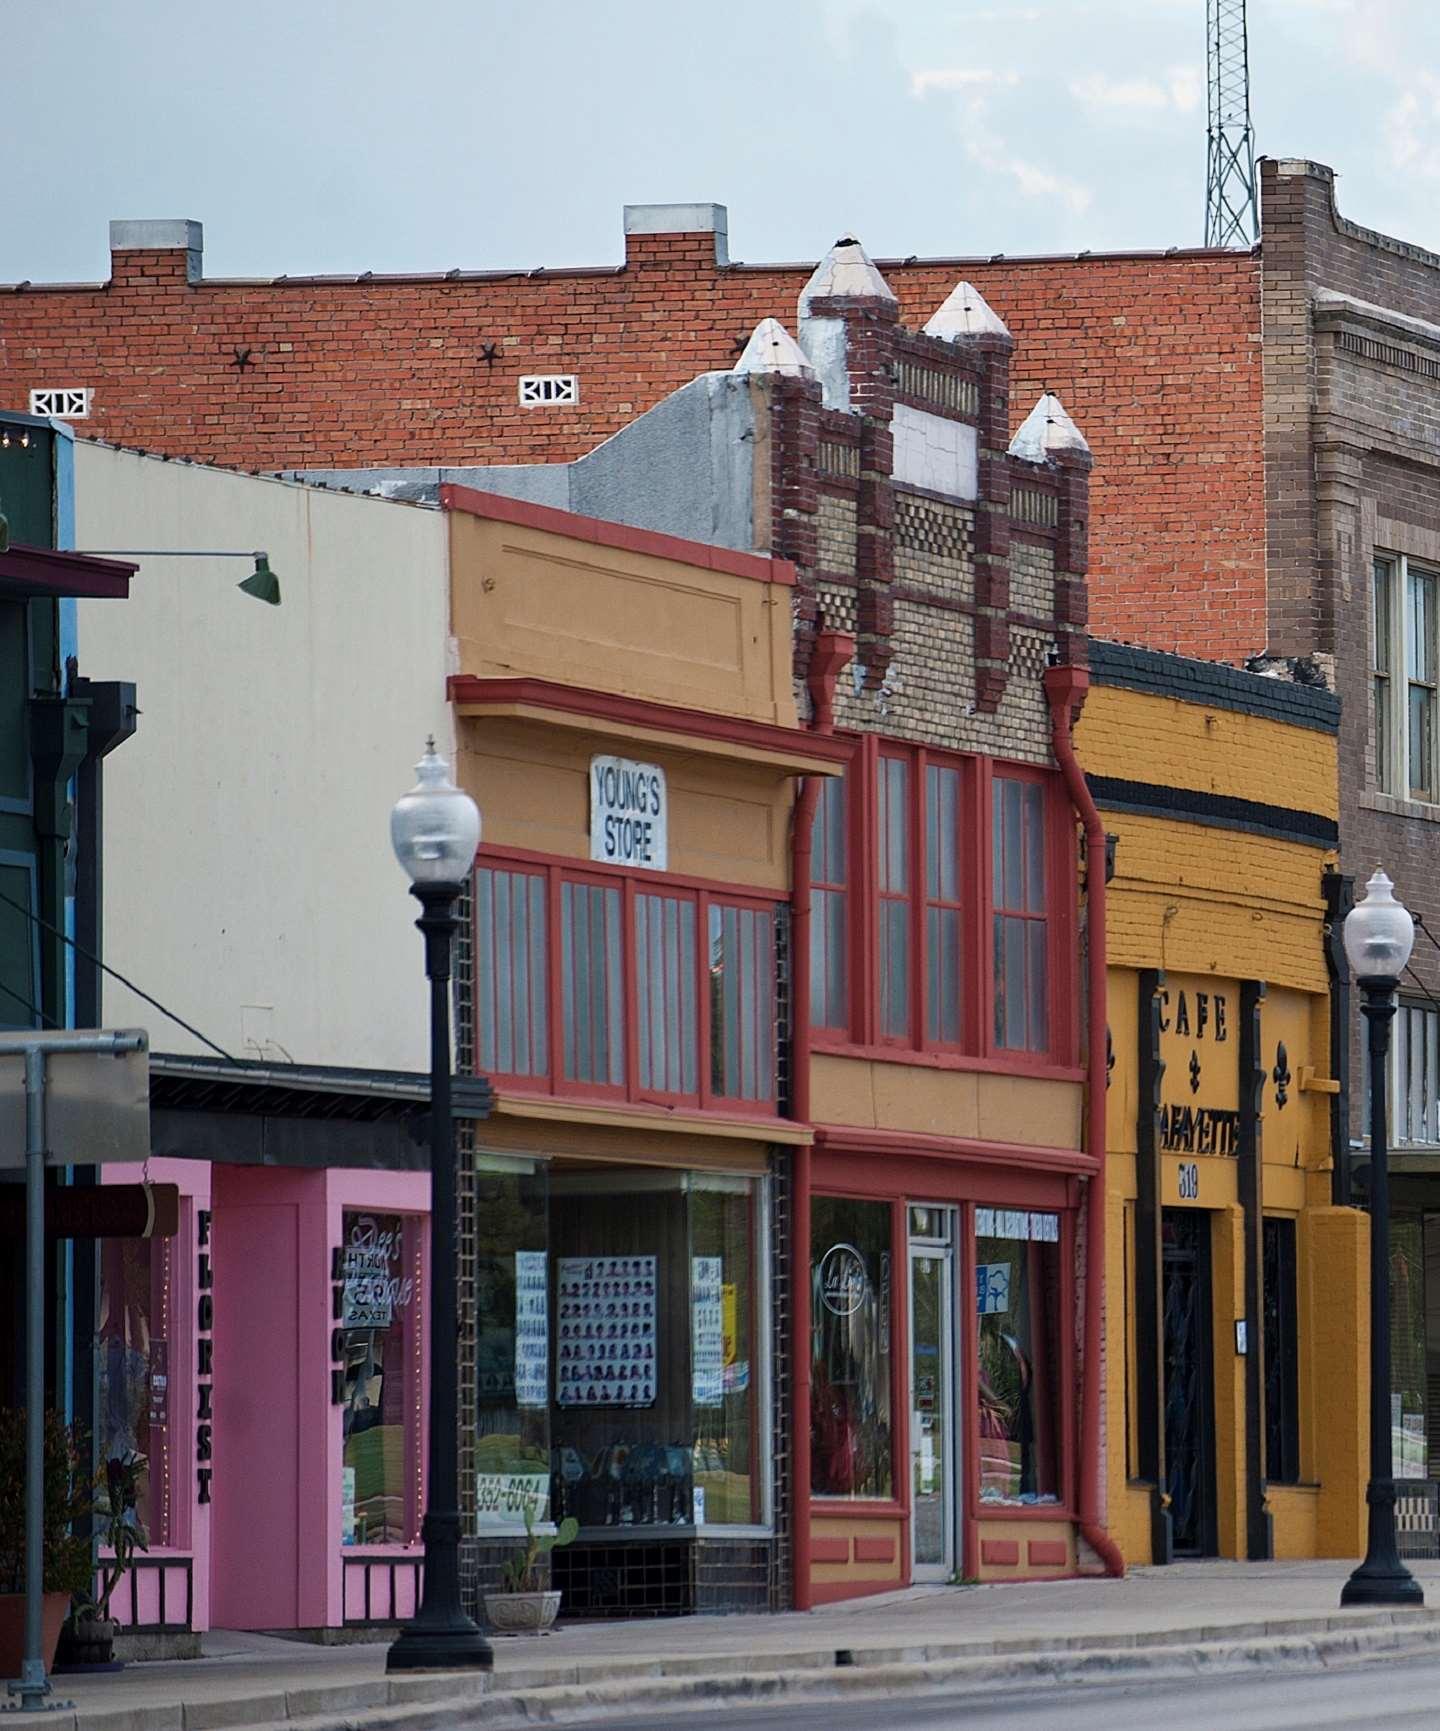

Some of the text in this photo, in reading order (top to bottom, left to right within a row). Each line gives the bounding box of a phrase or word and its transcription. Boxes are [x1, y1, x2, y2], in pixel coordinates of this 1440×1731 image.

[594, 765, 660, 816] YOUNG'S
[605, 814, 652, 862] STORE
[1159, 990, 1227, 1041] CAFE
[1160, 1104, 1240, 1157] AFAYETTE
[197, 1210, 212, 1504] FLORIST
